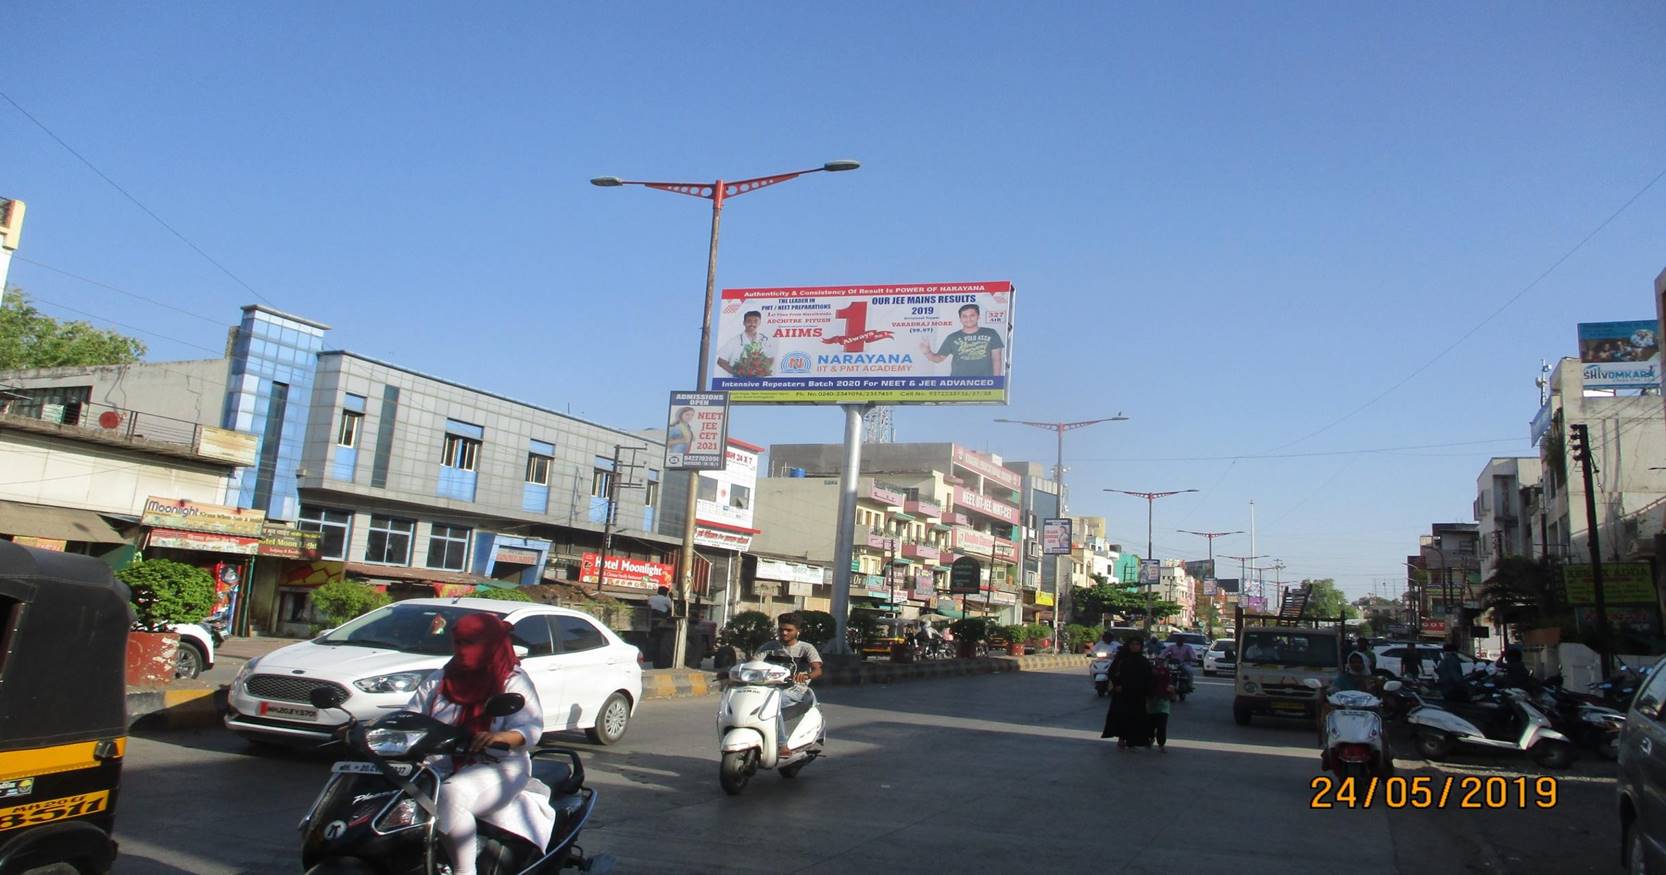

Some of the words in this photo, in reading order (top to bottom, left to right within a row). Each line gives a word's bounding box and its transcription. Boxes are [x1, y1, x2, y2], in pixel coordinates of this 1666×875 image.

[744, 290, 789, 298] Authenticity
[799, 288, 846, 297] Consistency
[859, 287, 884, 295] Result
[895, 286, 924, 294] POWER
[940, 284, 985, 293] NARAYANA
[872, 297, 890, 306] OUR
[892, 296, 906, 305] JEE
[907, 295, 936, 305] MAINS
[937, 294, 977, 304] RESULTS
[911, 306, 934, 315] 2019
[772, 327, 823, 338] AIIMS
[843, 331, 875, 345] Always
[817, 353, 913, 365] NARAYANA
[816, 365, 831, 373] IIT
[831, 365, 839, 373] &
[839, 365, 863, 373] PMT
[863, 364, 913, 372] ACADEMY
[762, 380, 806, 389] Repeaters
[808, 380, 834, 388] Batch
[939, 379, 994, 387] ADVANCED
[697, 411, 723, 421] NEET
[702, 421, 718, 431] JEE
[699, 431, 718, 440] CET
[696, 442, 719, 450] 2021
[147, 501, 199, 518] Moonlight
[621, 560, 663, 576] Moonlight
